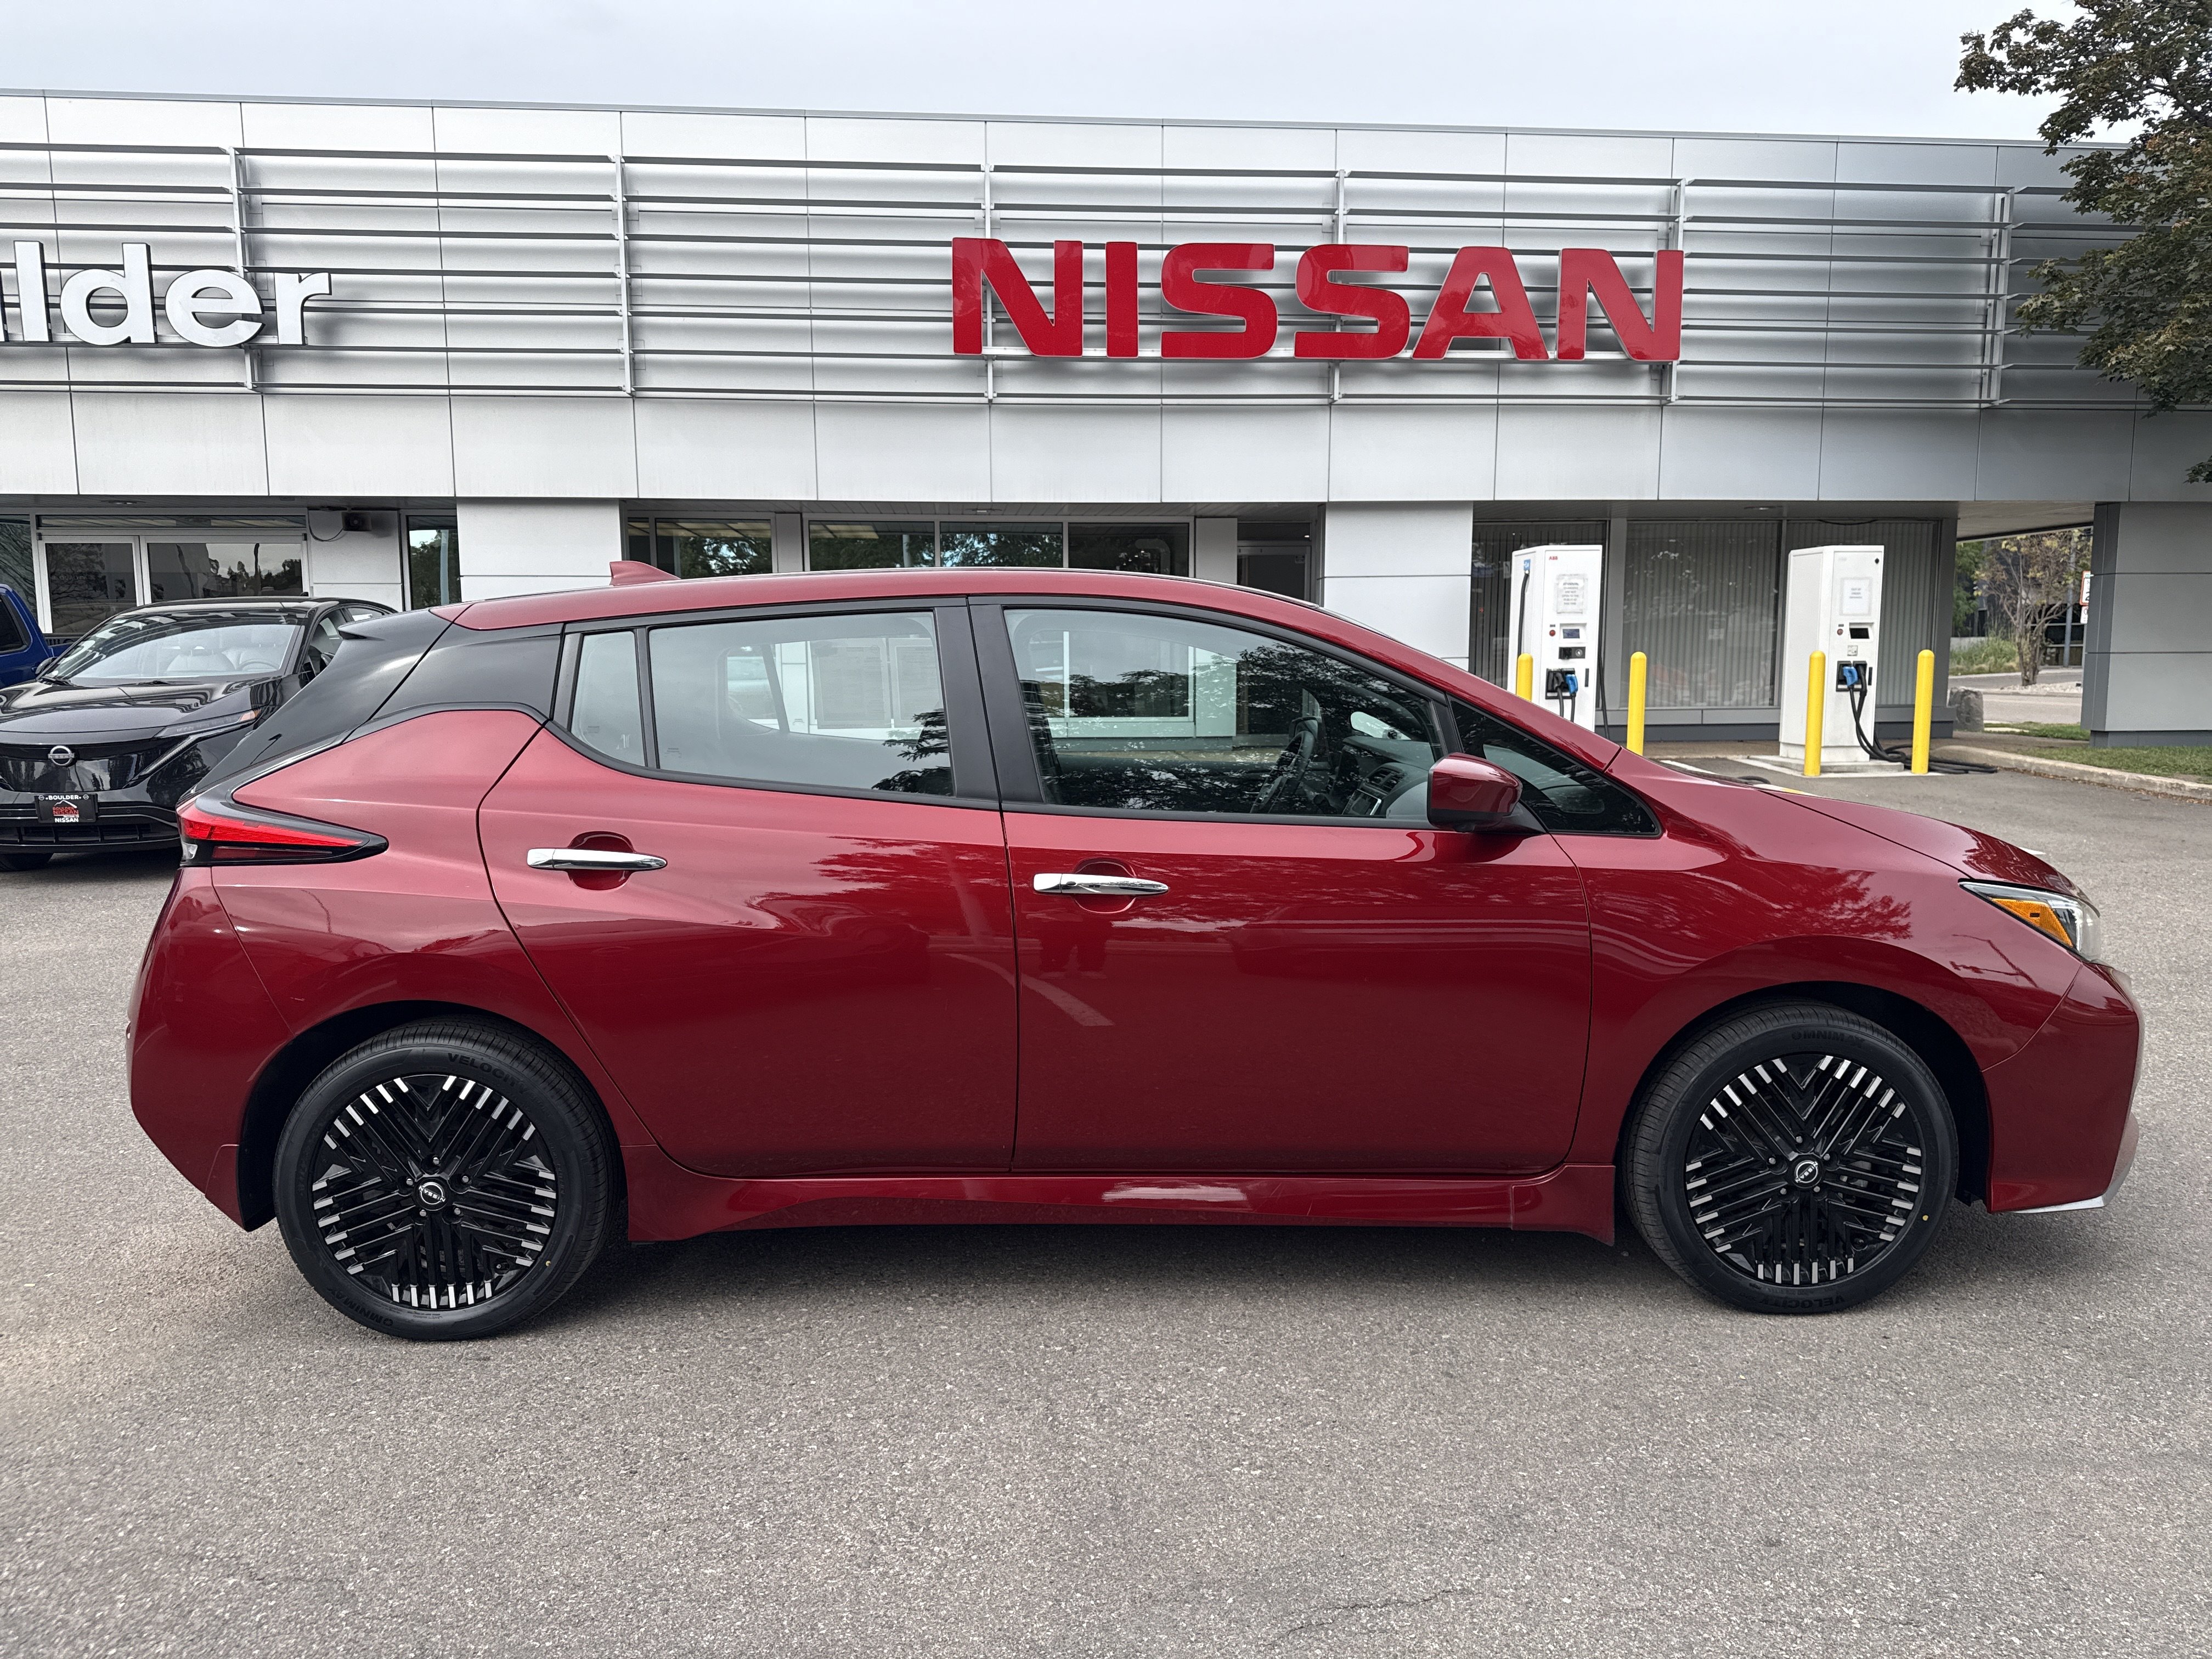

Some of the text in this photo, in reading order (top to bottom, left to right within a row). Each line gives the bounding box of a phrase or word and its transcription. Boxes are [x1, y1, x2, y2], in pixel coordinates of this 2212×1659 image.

[0, 240, 331, 347] lder
[952, 237, 1684, 362] NISSAN
[448, 1053, 528, 1096] VELOCITY
[1795, 1161, 1818, 1183] NISSAN
[419, 1186, 445, 1202] NISSAN
